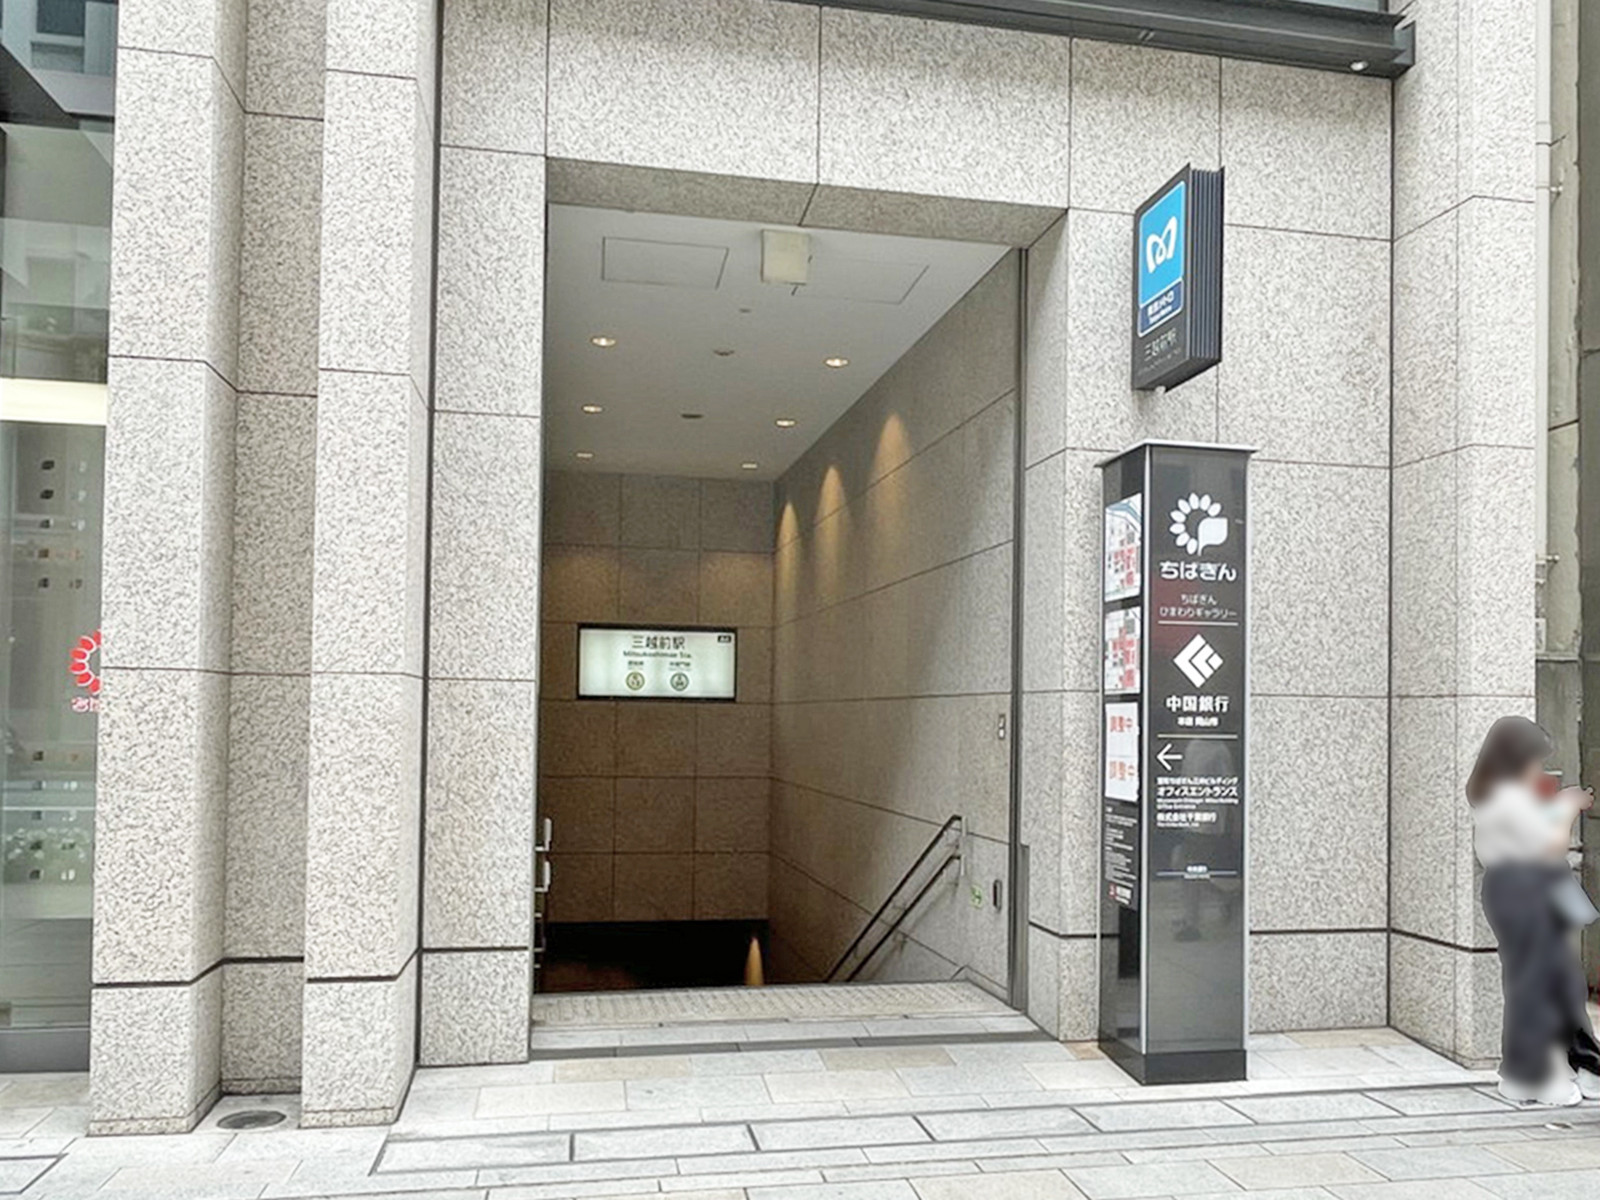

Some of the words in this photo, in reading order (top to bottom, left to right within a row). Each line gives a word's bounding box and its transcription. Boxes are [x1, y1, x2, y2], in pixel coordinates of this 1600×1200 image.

[1159, 560, 1237, 582] ちばぎん
[1180, 594, 1218, 606] ちばぎん
[1159, 606, 1237, 620] ひまわりギャラリー
[632, 635, 685, 650] 三越前駅
[1166, 695, 1229, 712] 中国銀行
[1156, 786, 1238, 797] オフィスエントランス
